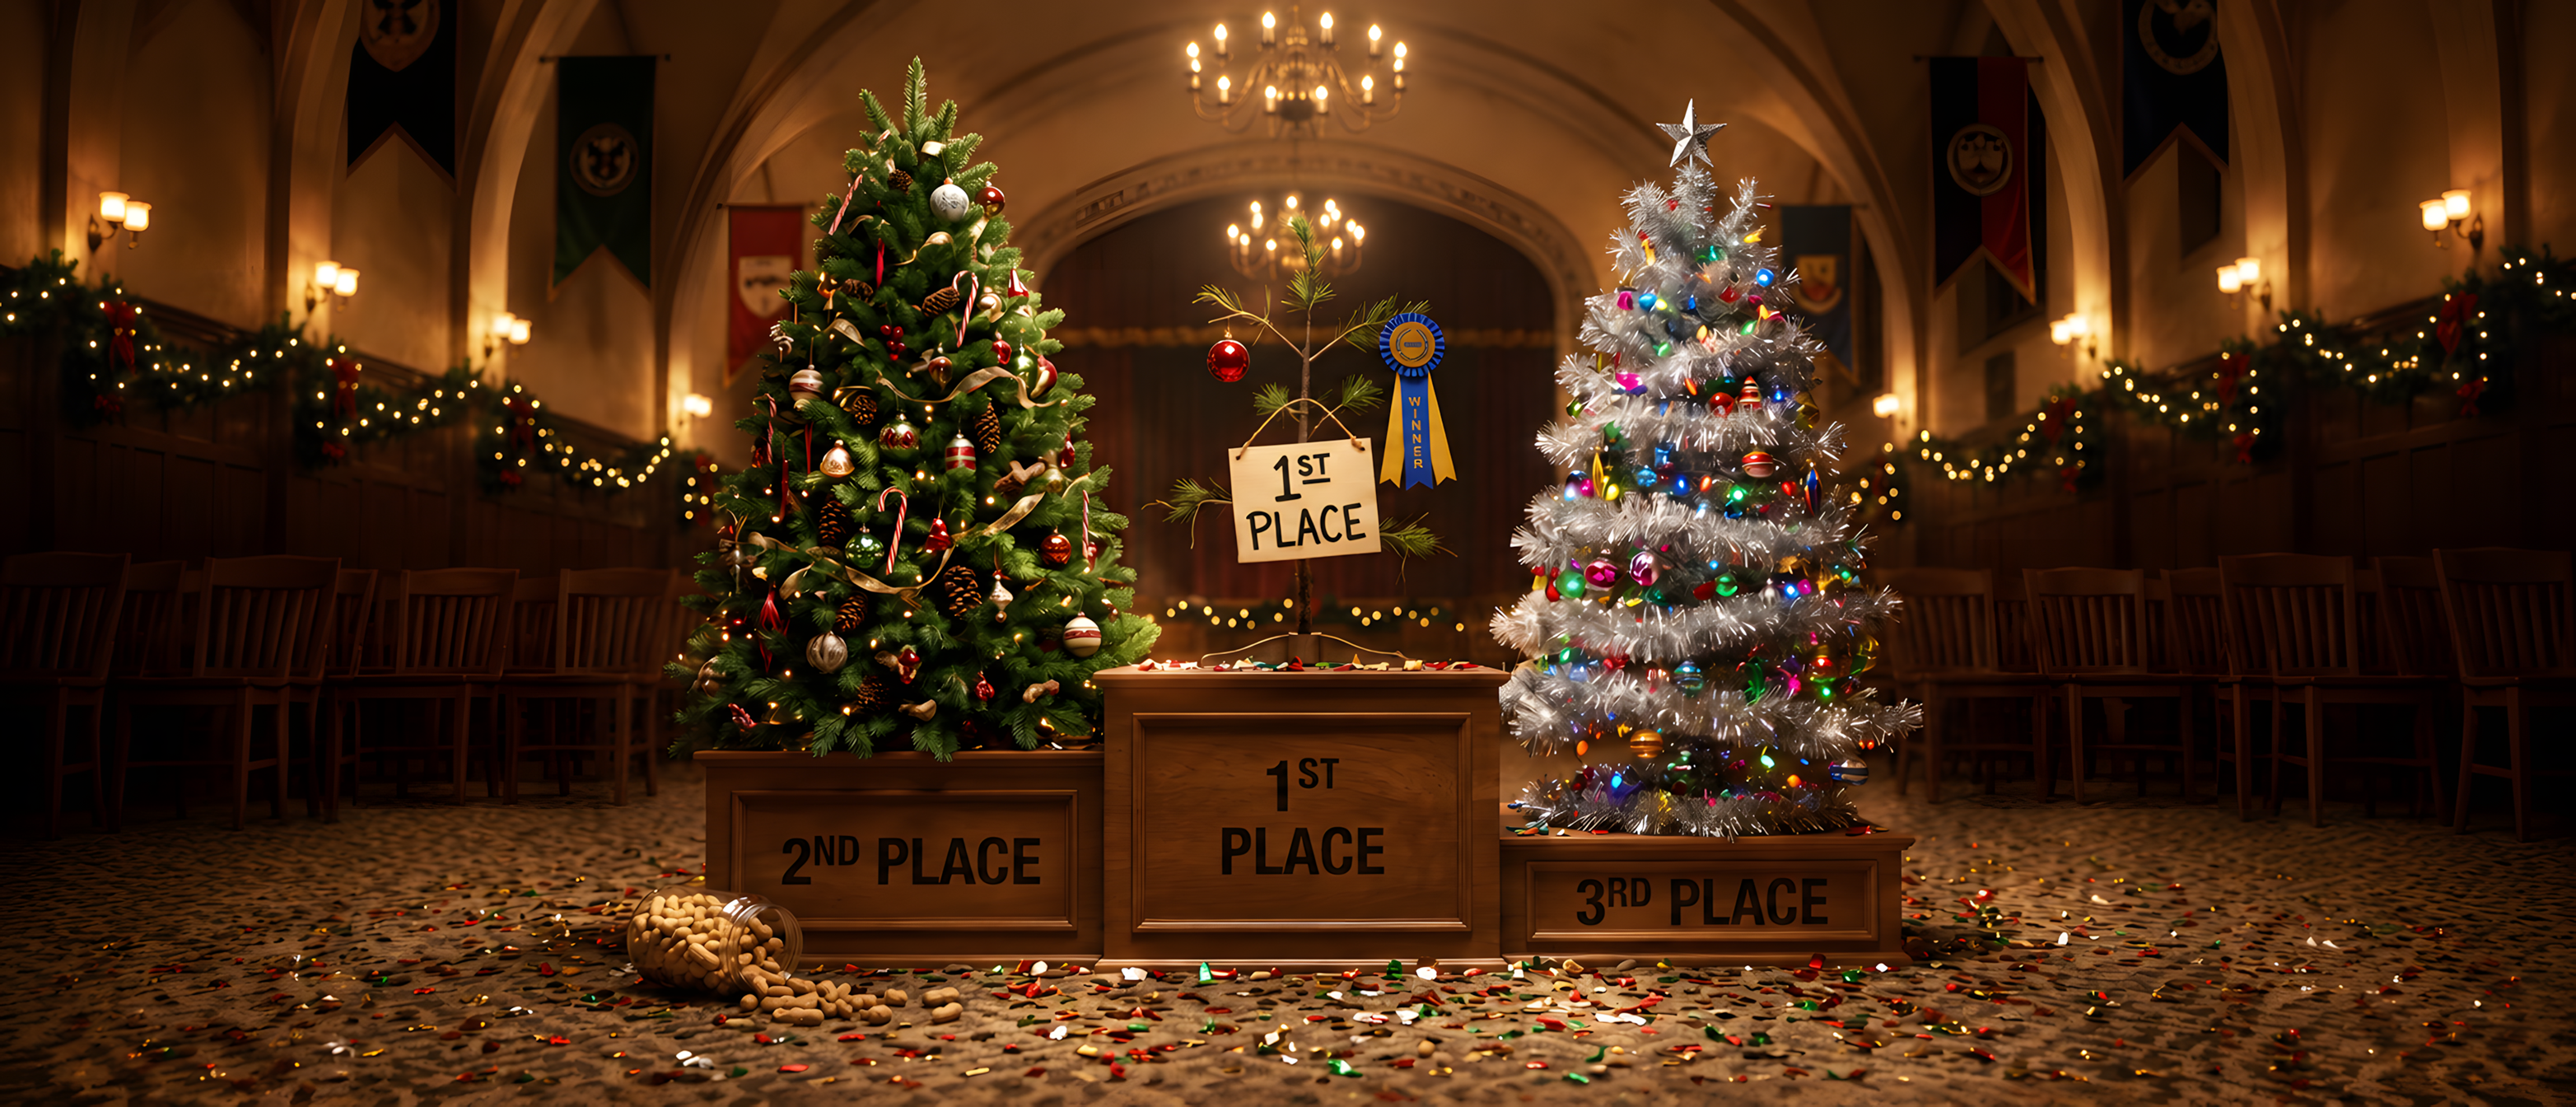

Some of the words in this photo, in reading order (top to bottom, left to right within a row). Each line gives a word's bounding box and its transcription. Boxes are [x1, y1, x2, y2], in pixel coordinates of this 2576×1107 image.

[1408, 396, 1423, 469] WINNER
[1273, 453, 1331, 502] 1ST
[1246, 502, 1366, 550] PLACE
[1267, 757, 1339, 811] 1ST
[782, 835, 860, 885] 2ND
[878, 837, 1040, 885] PLACE
[1221, 826, 1384, 875] PLACE
[1576, 877, 1651, 926] 3RD
[1670, 877, 1828, 926] PLACE
